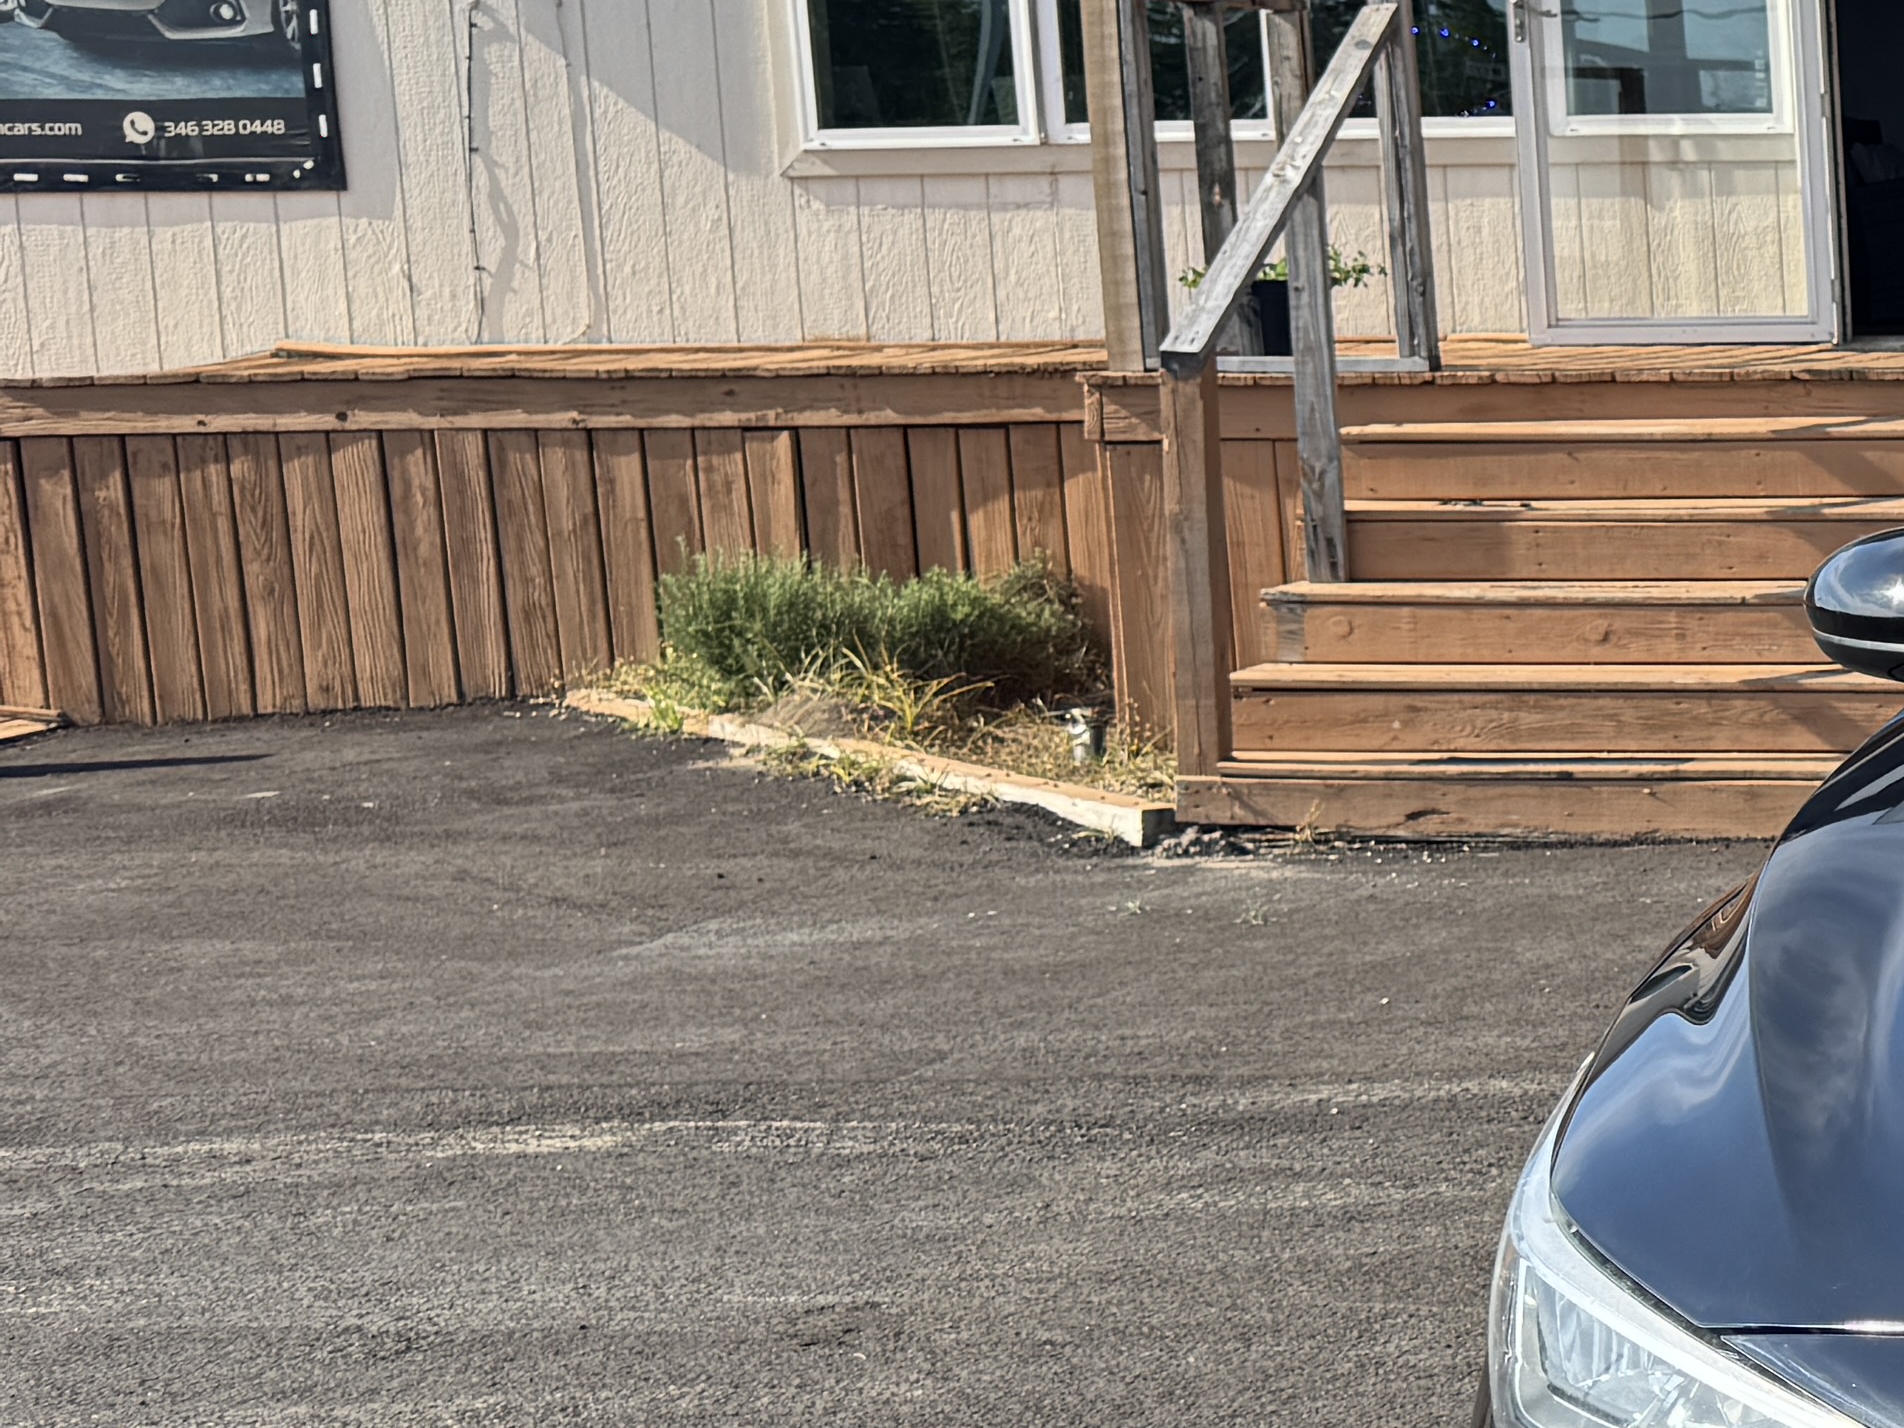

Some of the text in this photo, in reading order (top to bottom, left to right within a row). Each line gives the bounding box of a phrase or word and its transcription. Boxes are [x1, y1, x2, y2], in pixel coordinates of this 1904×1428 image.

[163, 119, 286, 137] 346 328 0448
